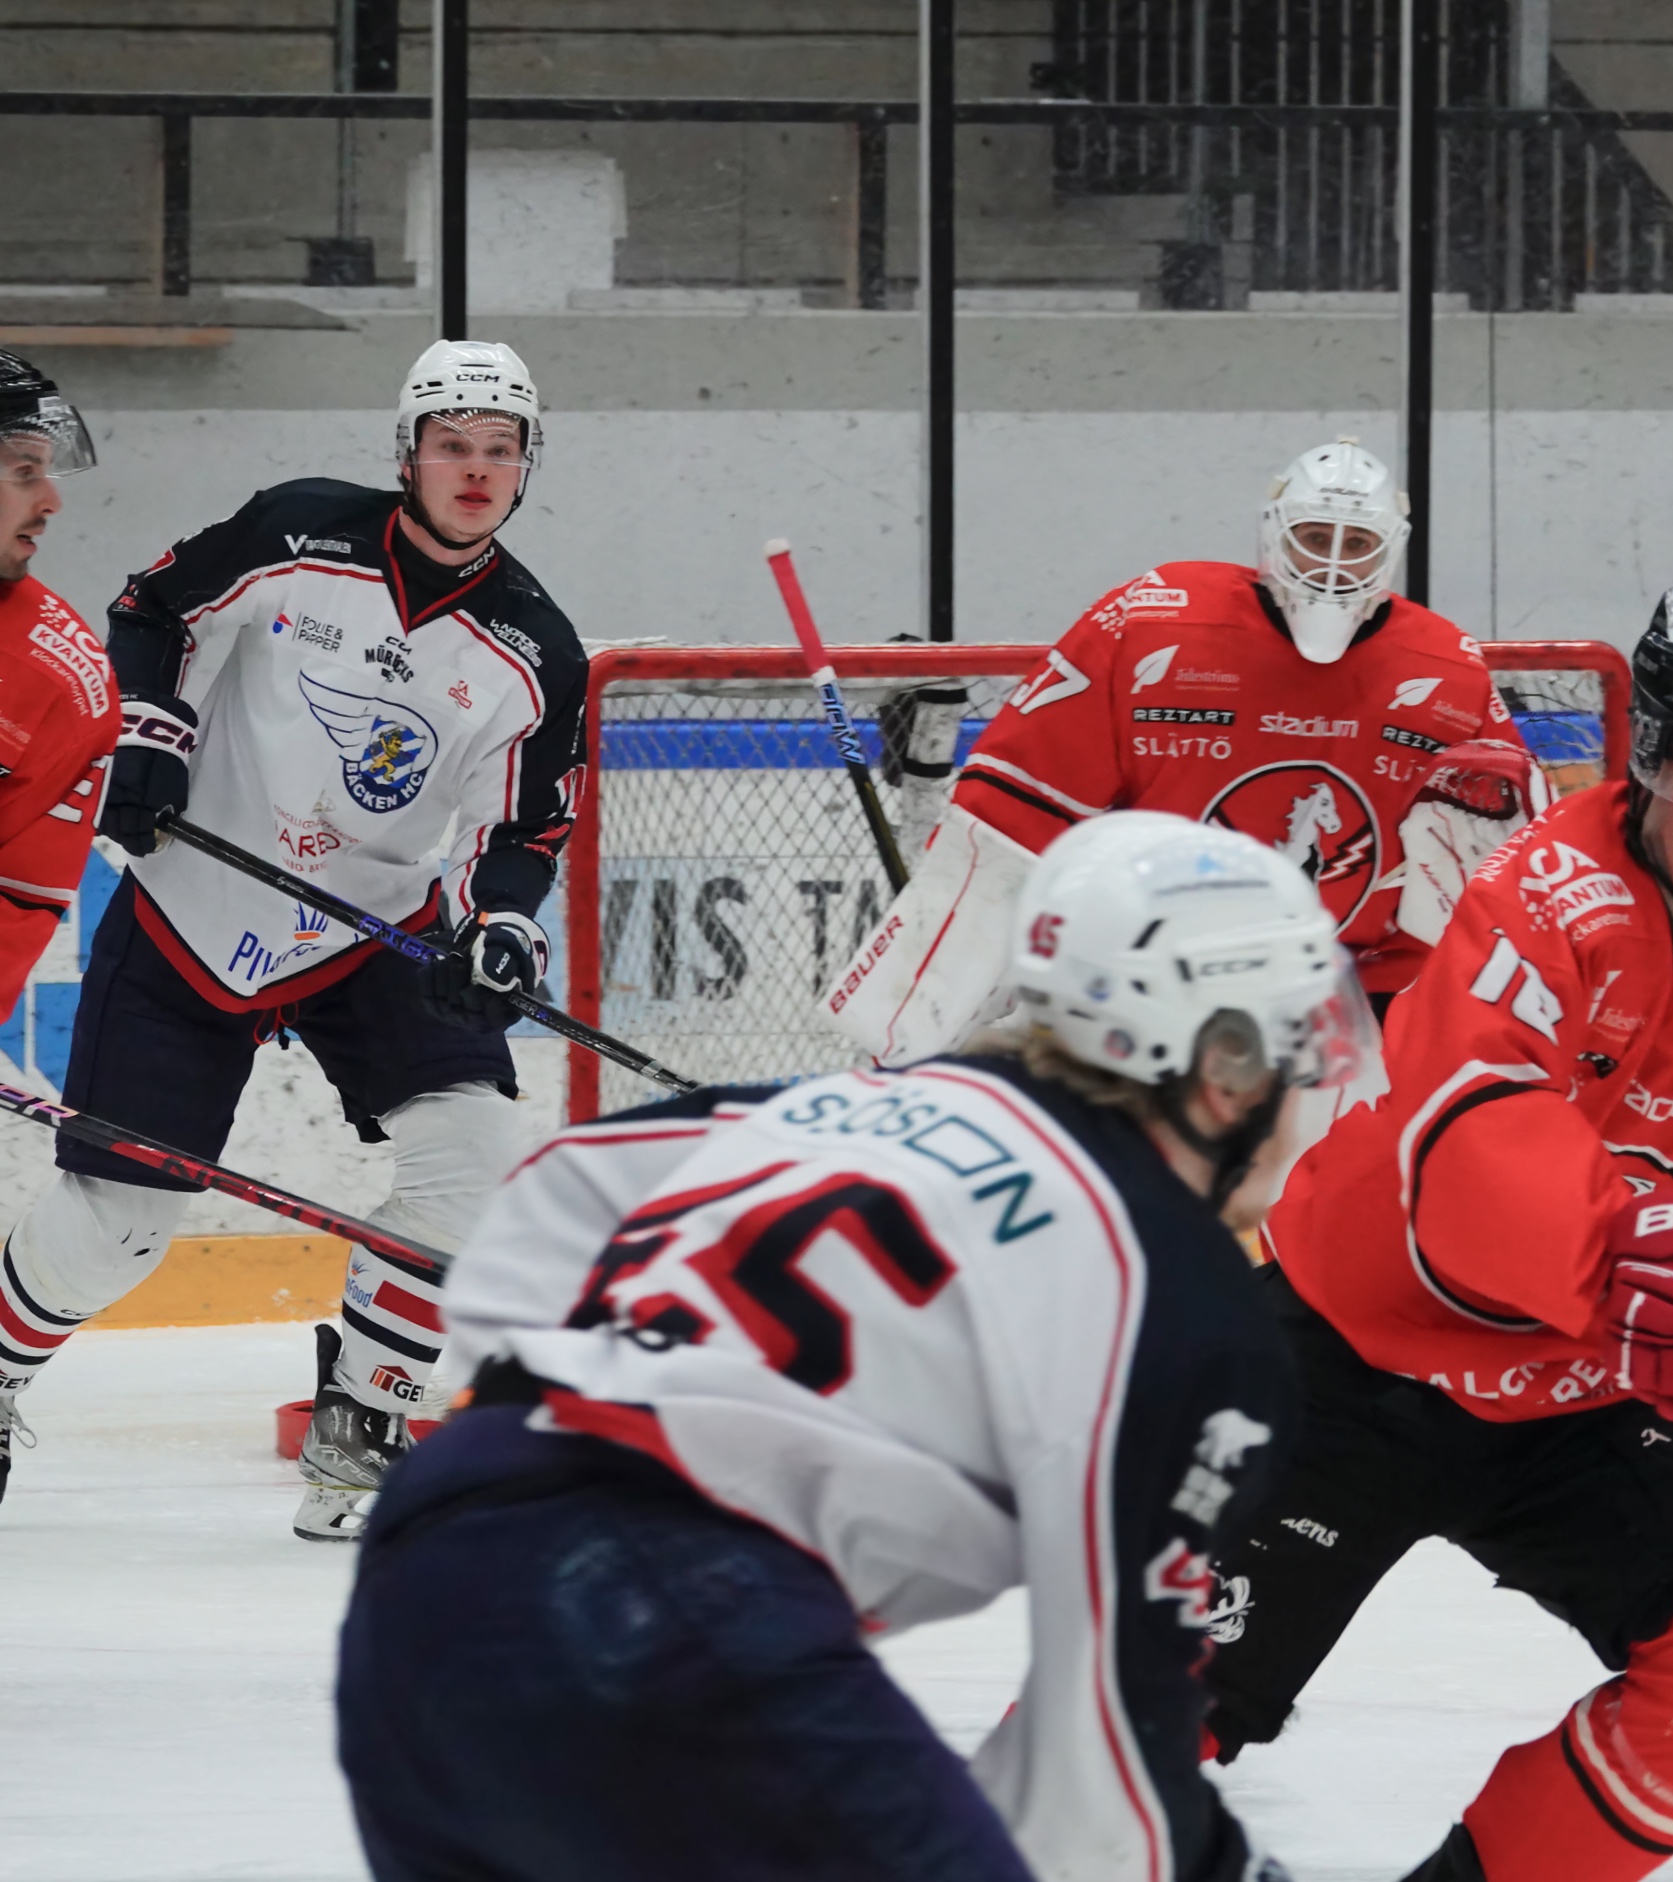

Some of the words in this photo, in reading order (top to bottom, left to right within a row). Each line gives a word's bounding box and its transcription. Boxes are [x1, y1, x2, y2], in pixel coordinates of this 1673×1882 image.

[456, 374, 500, 383] CCM
[458, 546, 496, 578] CCM
[36, 628, 106, 712] KVANTUM
[1133, 708, 1235, 724] REZTART
[1258, 711, 1359, 738] stadium
[346, 762, 398, 810] BÄCKEN
[400, 773, 424, 799] HC
[828, 914, 905, 1015] BAUER
